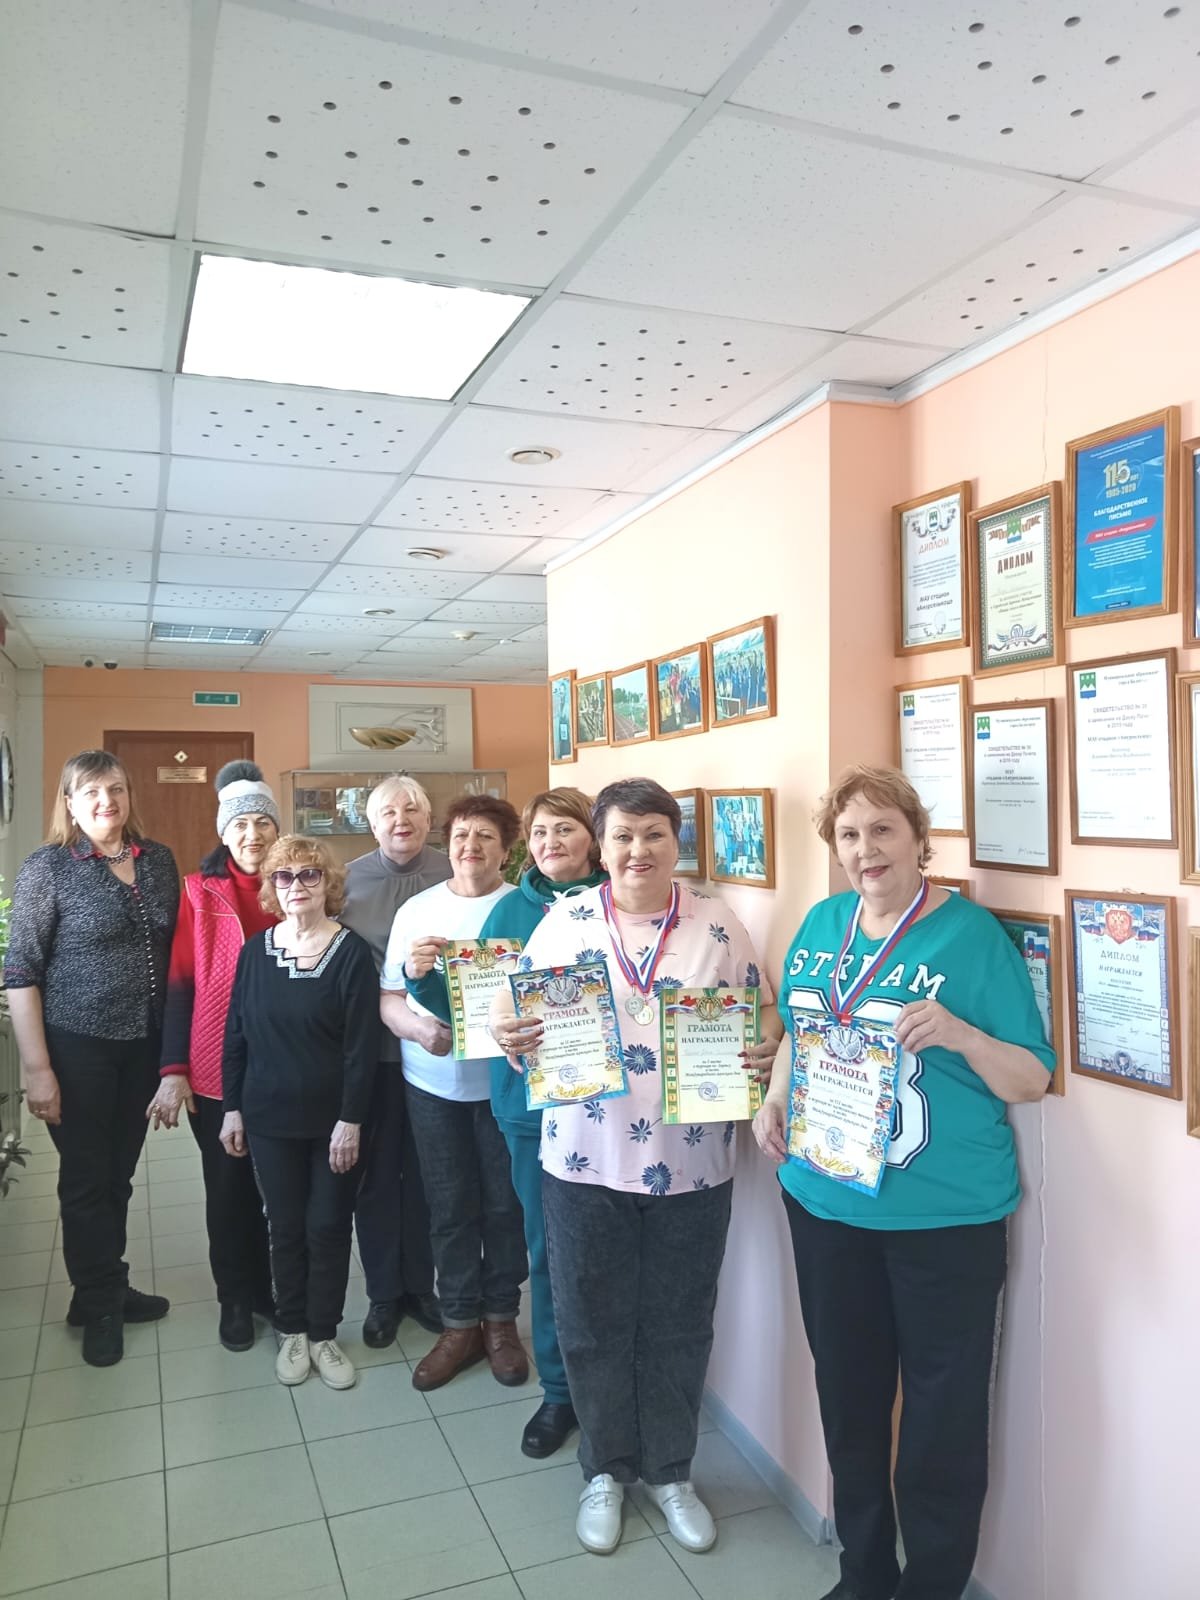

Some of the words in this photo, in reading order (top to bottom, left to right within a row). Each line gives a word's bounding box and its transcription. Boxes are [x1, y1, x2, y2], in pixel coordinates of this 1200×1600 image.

[1103, 459, 1130, 489] 115
[1093, 497, 1148, 517] БЛАГОДАРСТВЕННОЕ
[1109, 509, 1132, 521] ПИСЬМО
[918, 539, 950, 555] ДИПЛОМ
[997, 551, 1033, 574] ДИПЛОМ
[1100, 950, 1139, 963] ДИПЛОМ
[468, 970, 506, 980] ГРАМОТА
[543, 1007, 590, 1021] ГРАМОТА
[688, 1024, 732, 1032] ГРАМОТА
[819, 1060, 869, 1083] ГРАМОТА
[813, 1072, 873, 1096] НАГРАЖДАЕТСЯ
